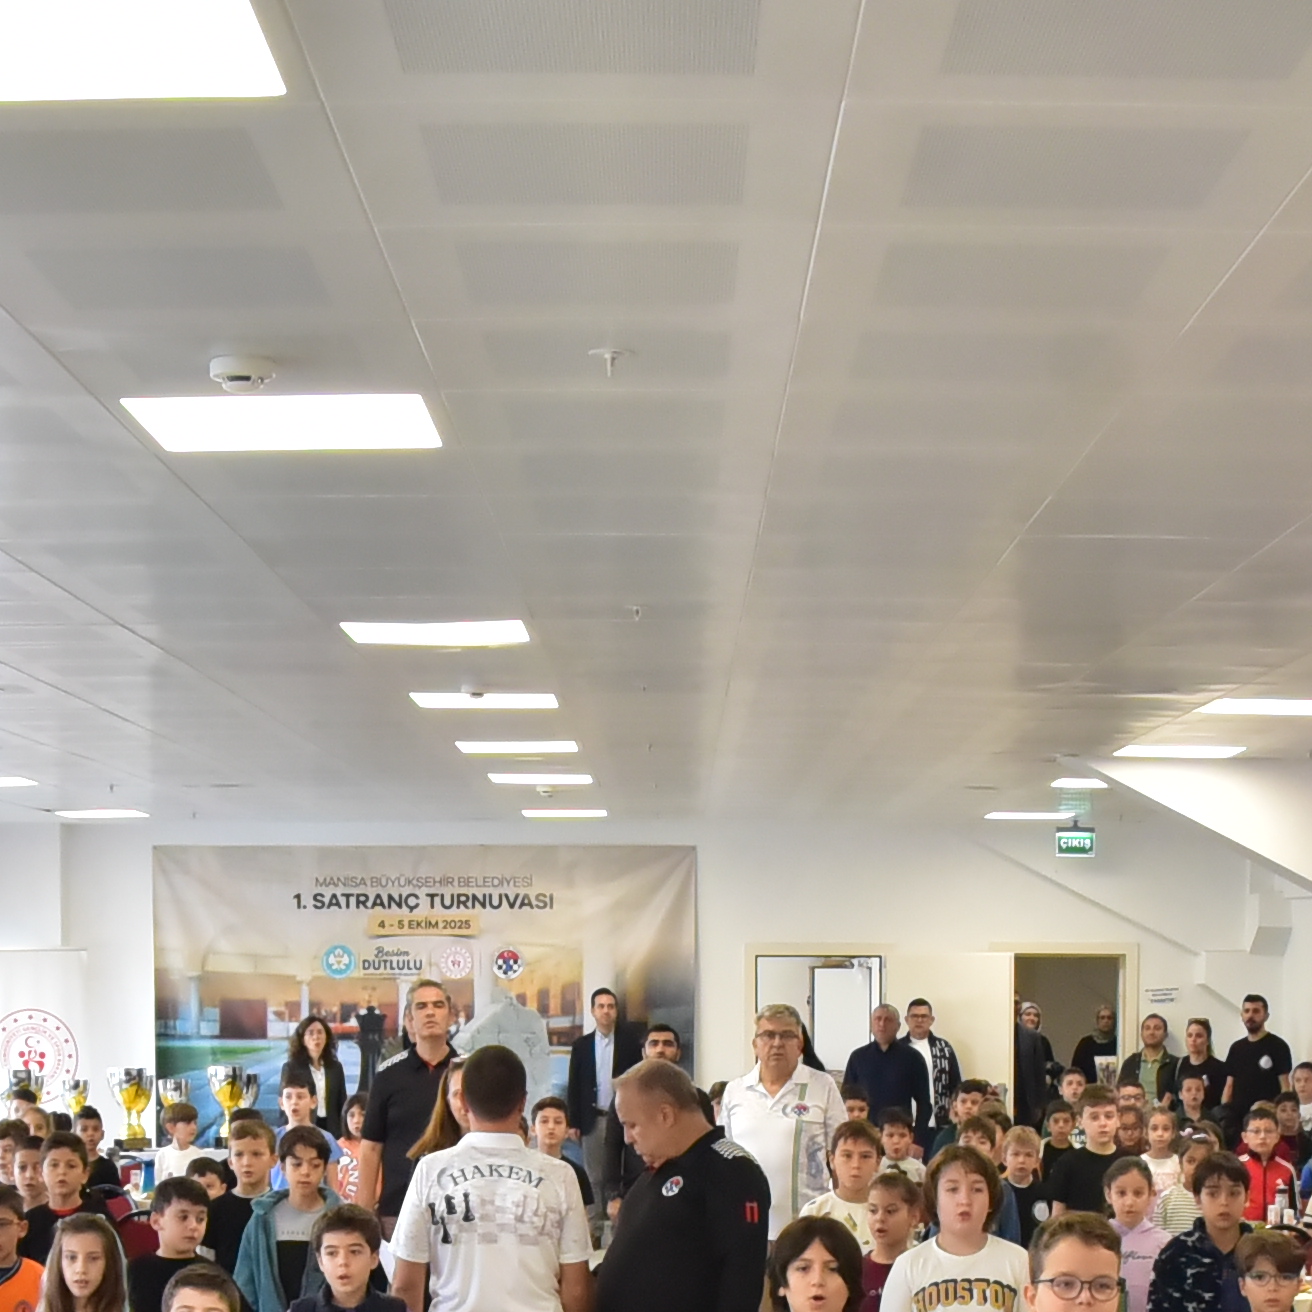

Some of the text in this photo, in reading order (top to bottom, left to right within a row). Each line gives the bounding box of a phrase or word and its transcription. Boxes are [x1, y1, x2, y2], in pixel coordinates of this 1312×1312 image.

[1060, 838, 1092, 850] ÇIKIŞ
[315, 874, 533, 890] MANİSA BÜYÜKŞEHİR BELEDİYESİ
[293, 893, 554, 913] 1. SATRANÇ TURNUVASI
[377, 919, 386, 930] 4
[397, 919, 405, 930] 5
[407, 916, 439, 930] EKİM
[441, 919, 471, 930] 2025
[362, 959, 423, 971] DUTLULU
[450, 1164, 545, 1189] HAKEM
